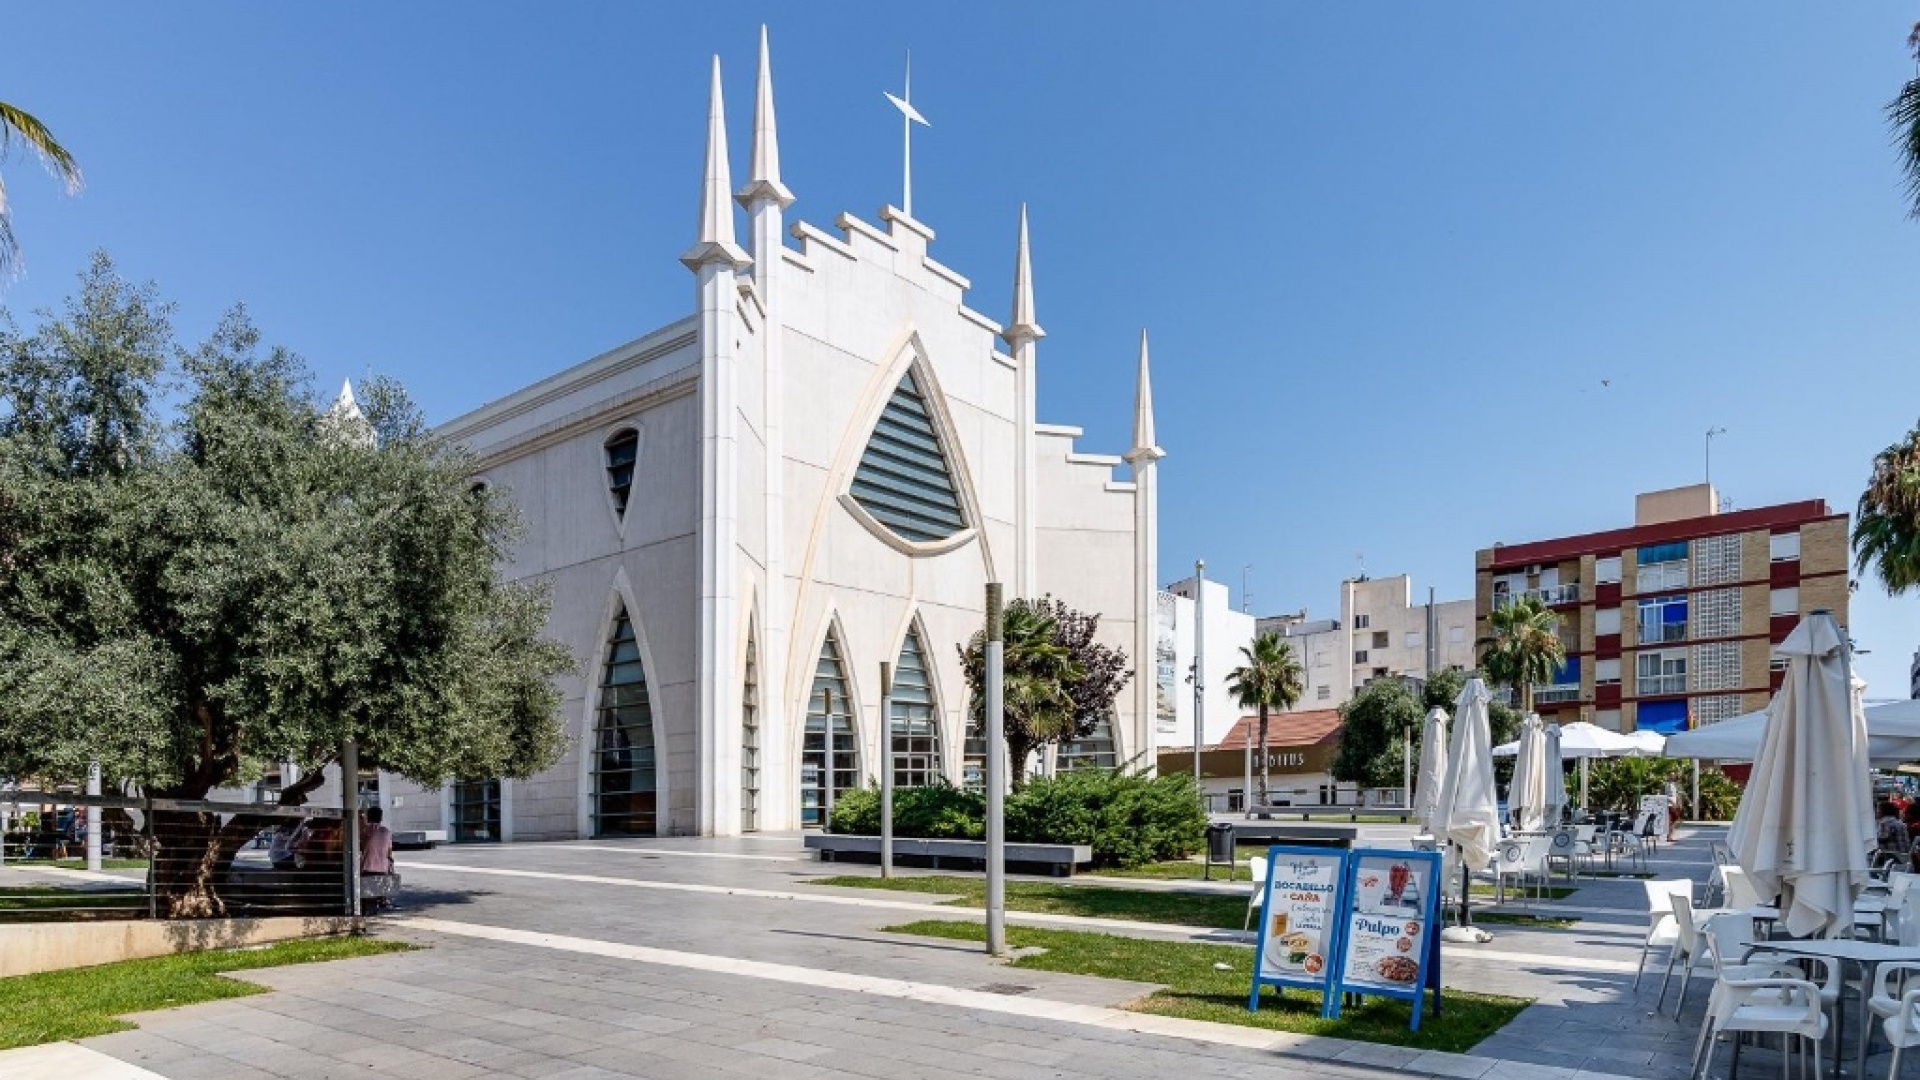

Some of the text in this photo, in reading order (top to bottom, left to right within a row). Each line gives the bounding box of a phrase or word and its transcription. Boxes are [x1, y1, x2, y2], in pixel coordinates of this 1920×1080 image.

[1253, 753, 1304, 768] BITUS
[1274, 880, 1334, 893] BOCADILLO
[1289, 892, 1321, 902] CAÑA
[1355, 919, 1400, 936] Pulpo
